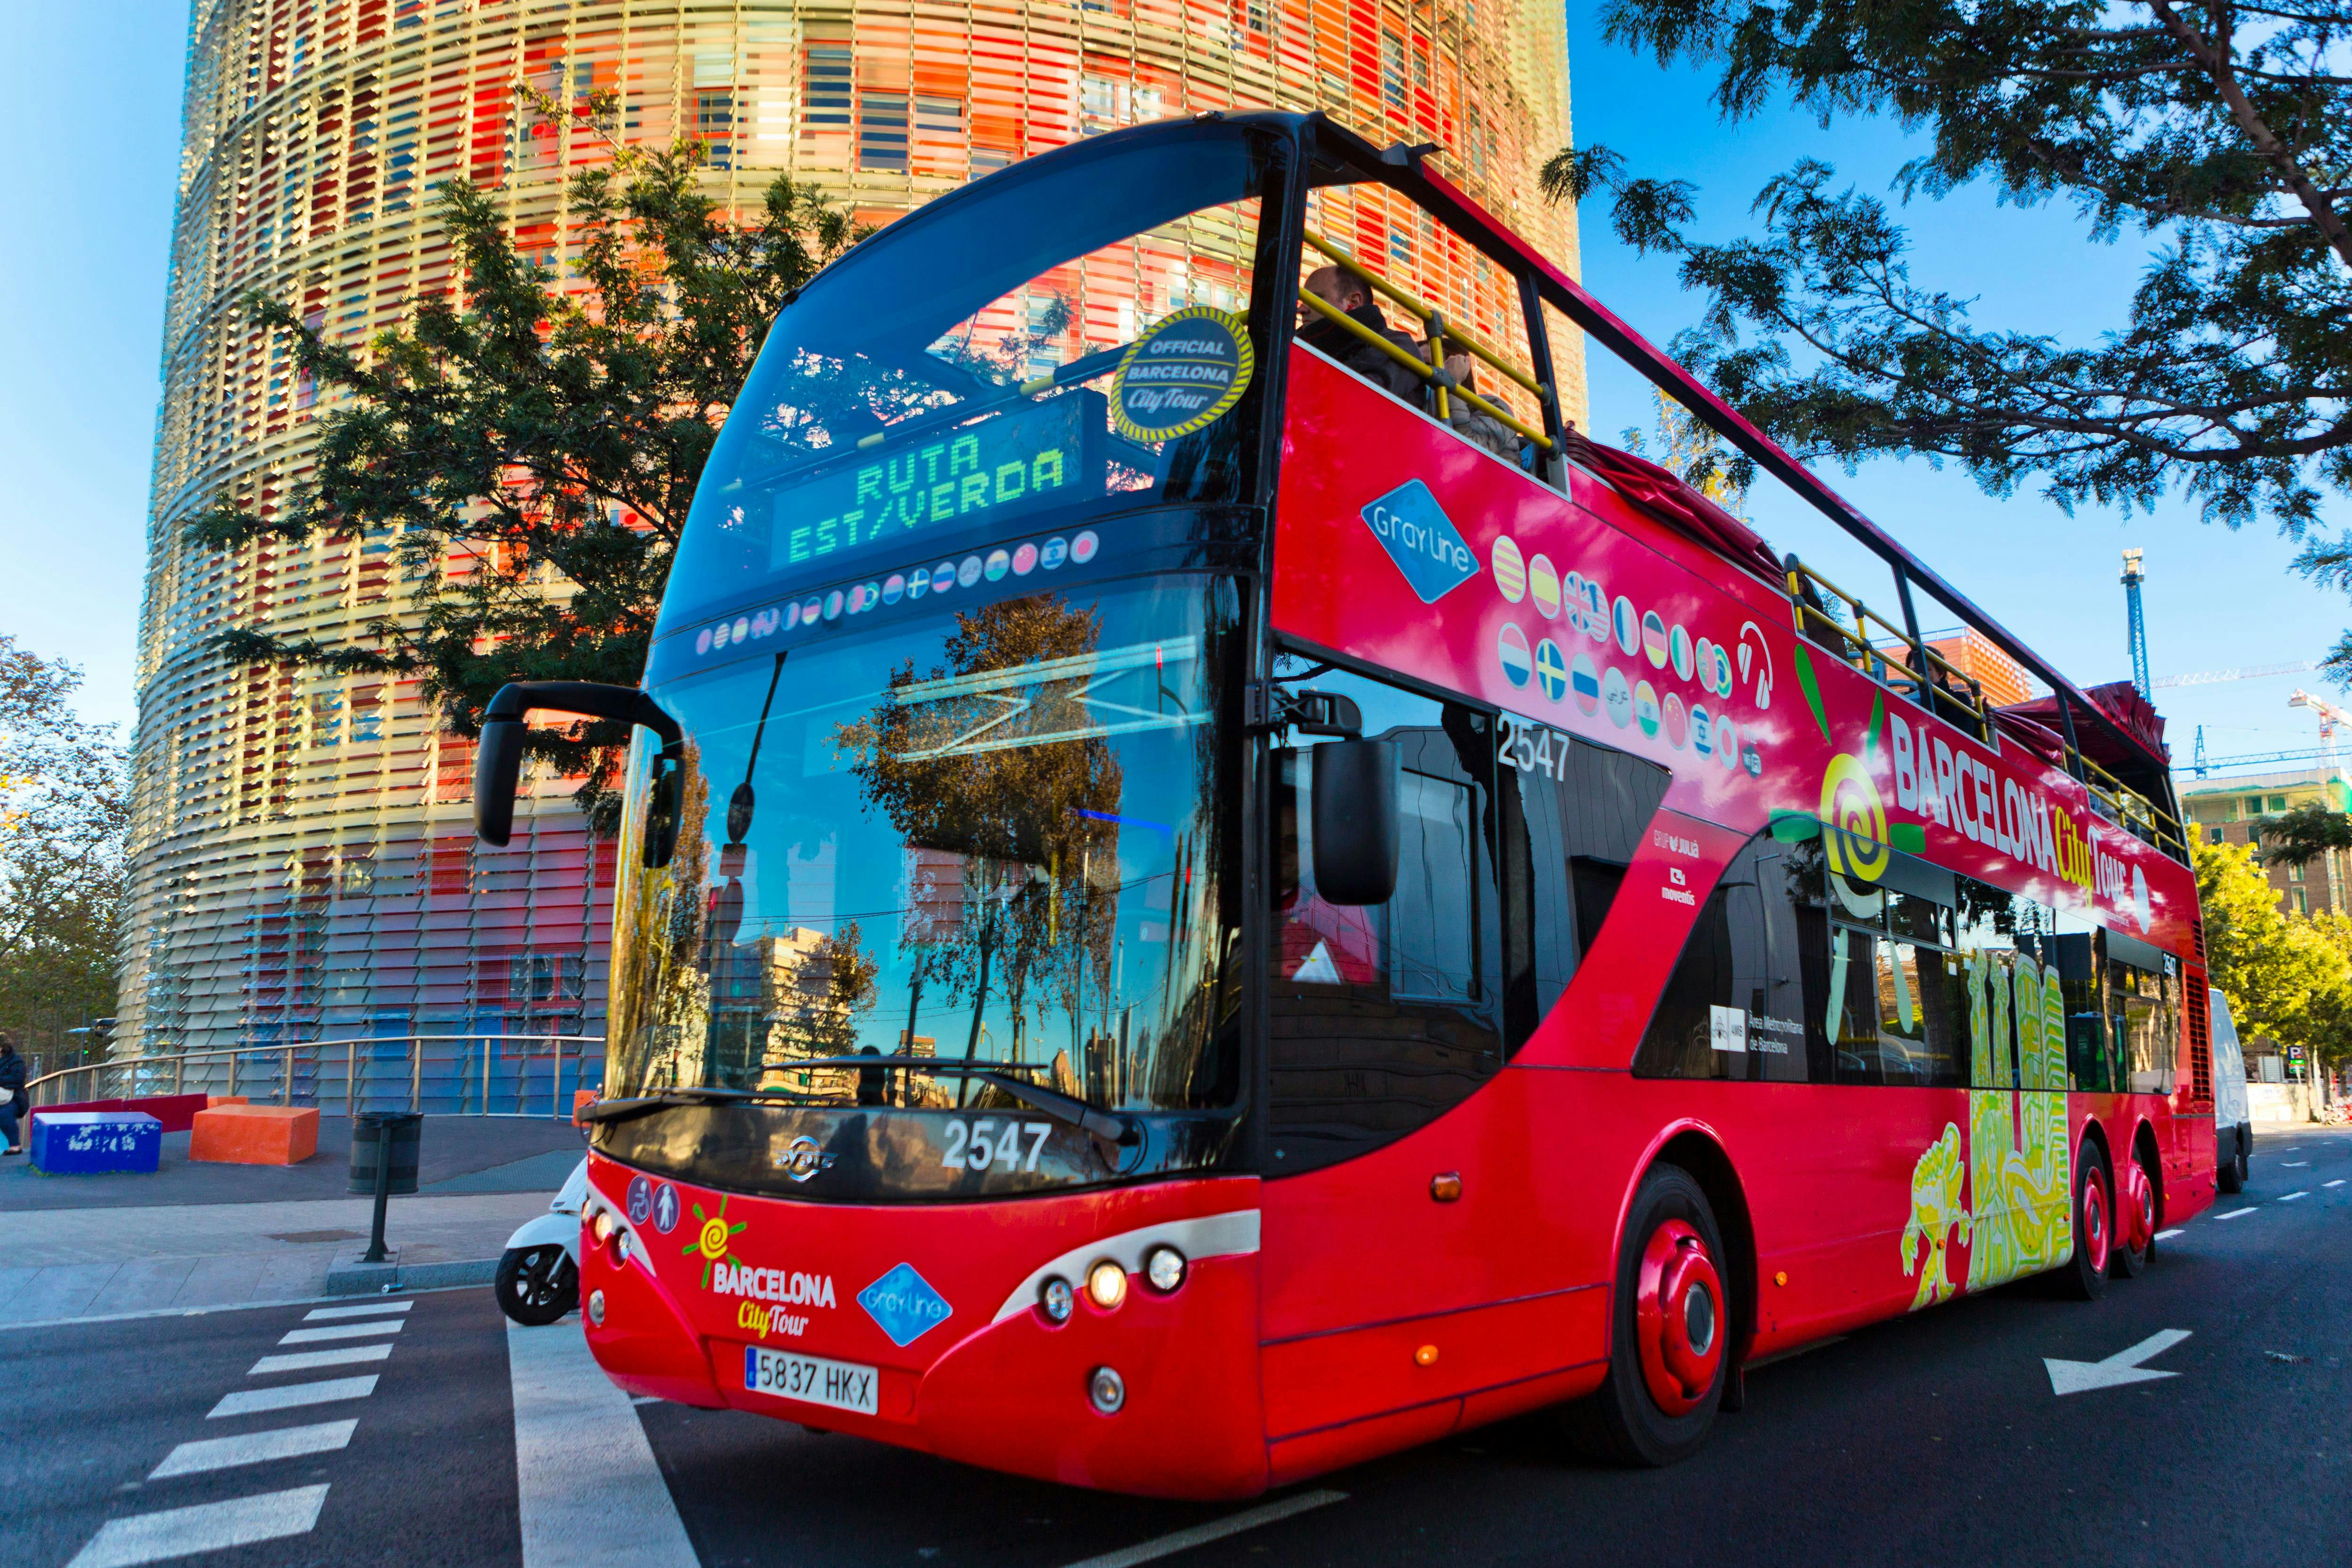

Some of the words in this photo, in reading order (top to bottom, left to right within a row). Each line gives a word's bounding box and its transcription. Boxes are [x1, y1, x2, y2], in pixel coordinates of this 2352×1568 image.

[1150, 339, 1224, 355] OFFICIAL
[1127, 366, 1229, 383] BARCELONA
[1128, 388, 1164, 413] City
[1164, 388, 1208, 409] Tour
[857, 434, 978, 505] RUTA
[789, 448, 1063, 563] EST/VERDA
[1497, 714, 1569, 782] 2547
[1890, 712, 2059, 876] BARCELONA
[2055, 806, 2093, 909] City
[2087, 825, 2126, 902] Tour
[1749, 1035, 1758, 1051] de
[1758, 1036, 1788, 1054] Barcelona
[1764, 1015, 1804, 1035] Metropolitana
[942, 1119, 1052, 1172] 2547
[714, 1263, 836, 1309] BARCELONA
[738, 1300, 771, 1339] City
[769, 1305, 809, 1336] Tour
[761, 1355, 817, 1394] 5837
[826, 1367, 870, 1407] HKX
